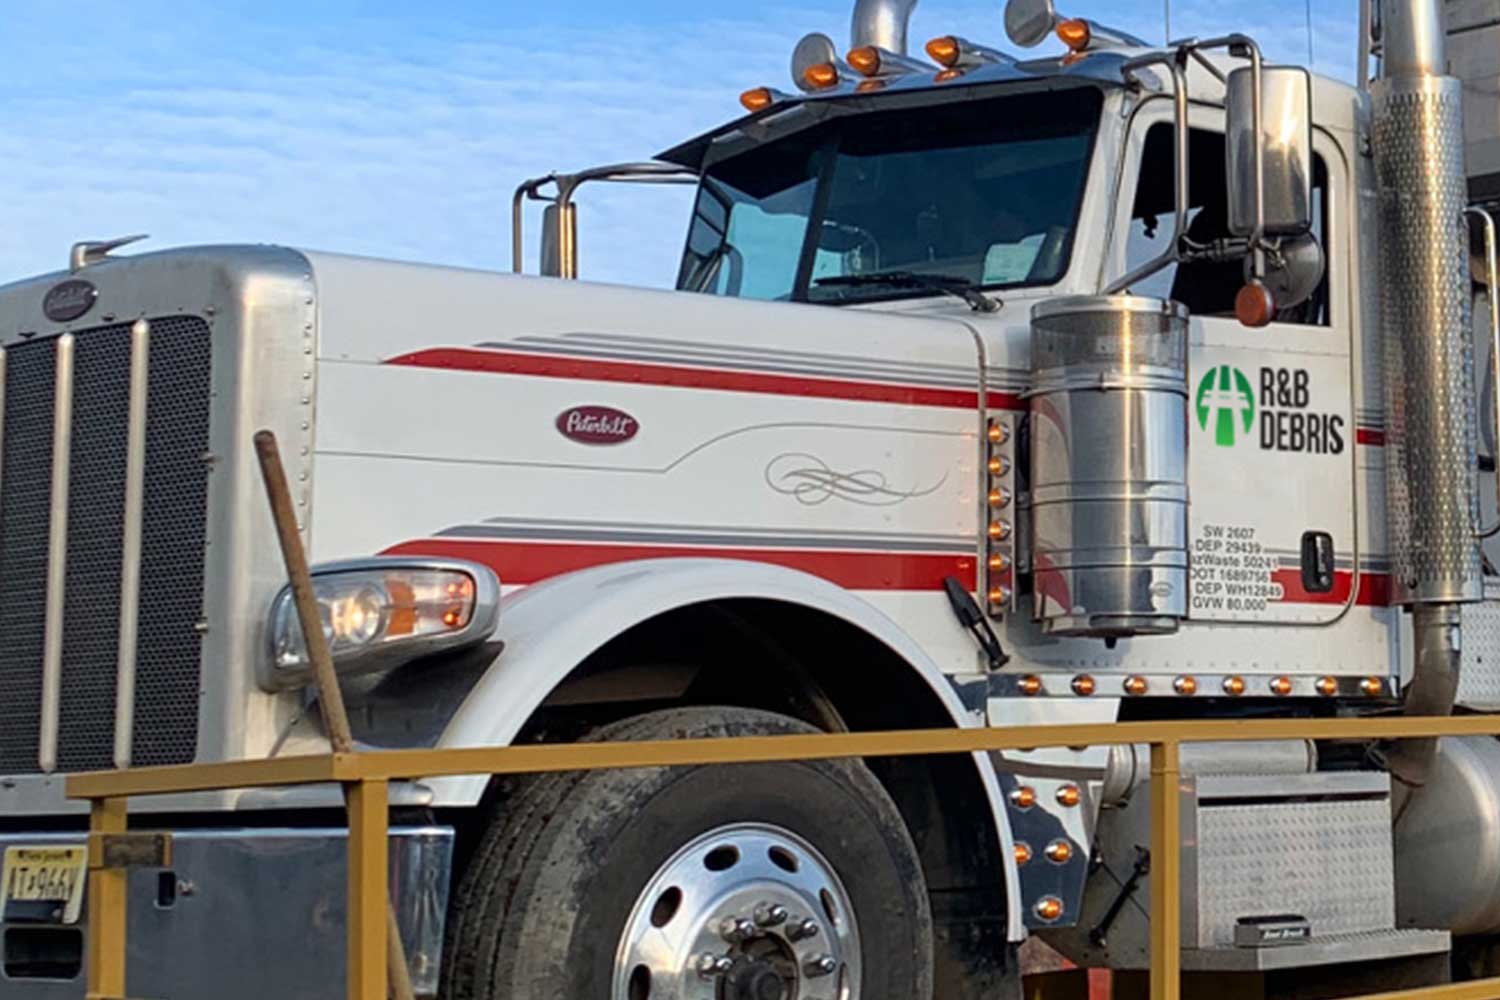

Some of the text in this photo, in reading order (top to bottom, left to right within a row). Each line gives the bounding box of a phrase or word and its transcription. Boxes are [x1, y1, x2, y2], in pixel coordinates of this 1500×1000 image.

[1259, 366, 1310, 409] R&B
[565, 410, 633, 436] Peterbilt
[1259, 411, 1345, 455] DEBRIS
[1203, 525, 1255, 539] SW 2607
[1195, 539, 1222, 552] DEP
[1195, 582, 1222, 594] DEP
[1192, 596, 1224, 609] GVW
